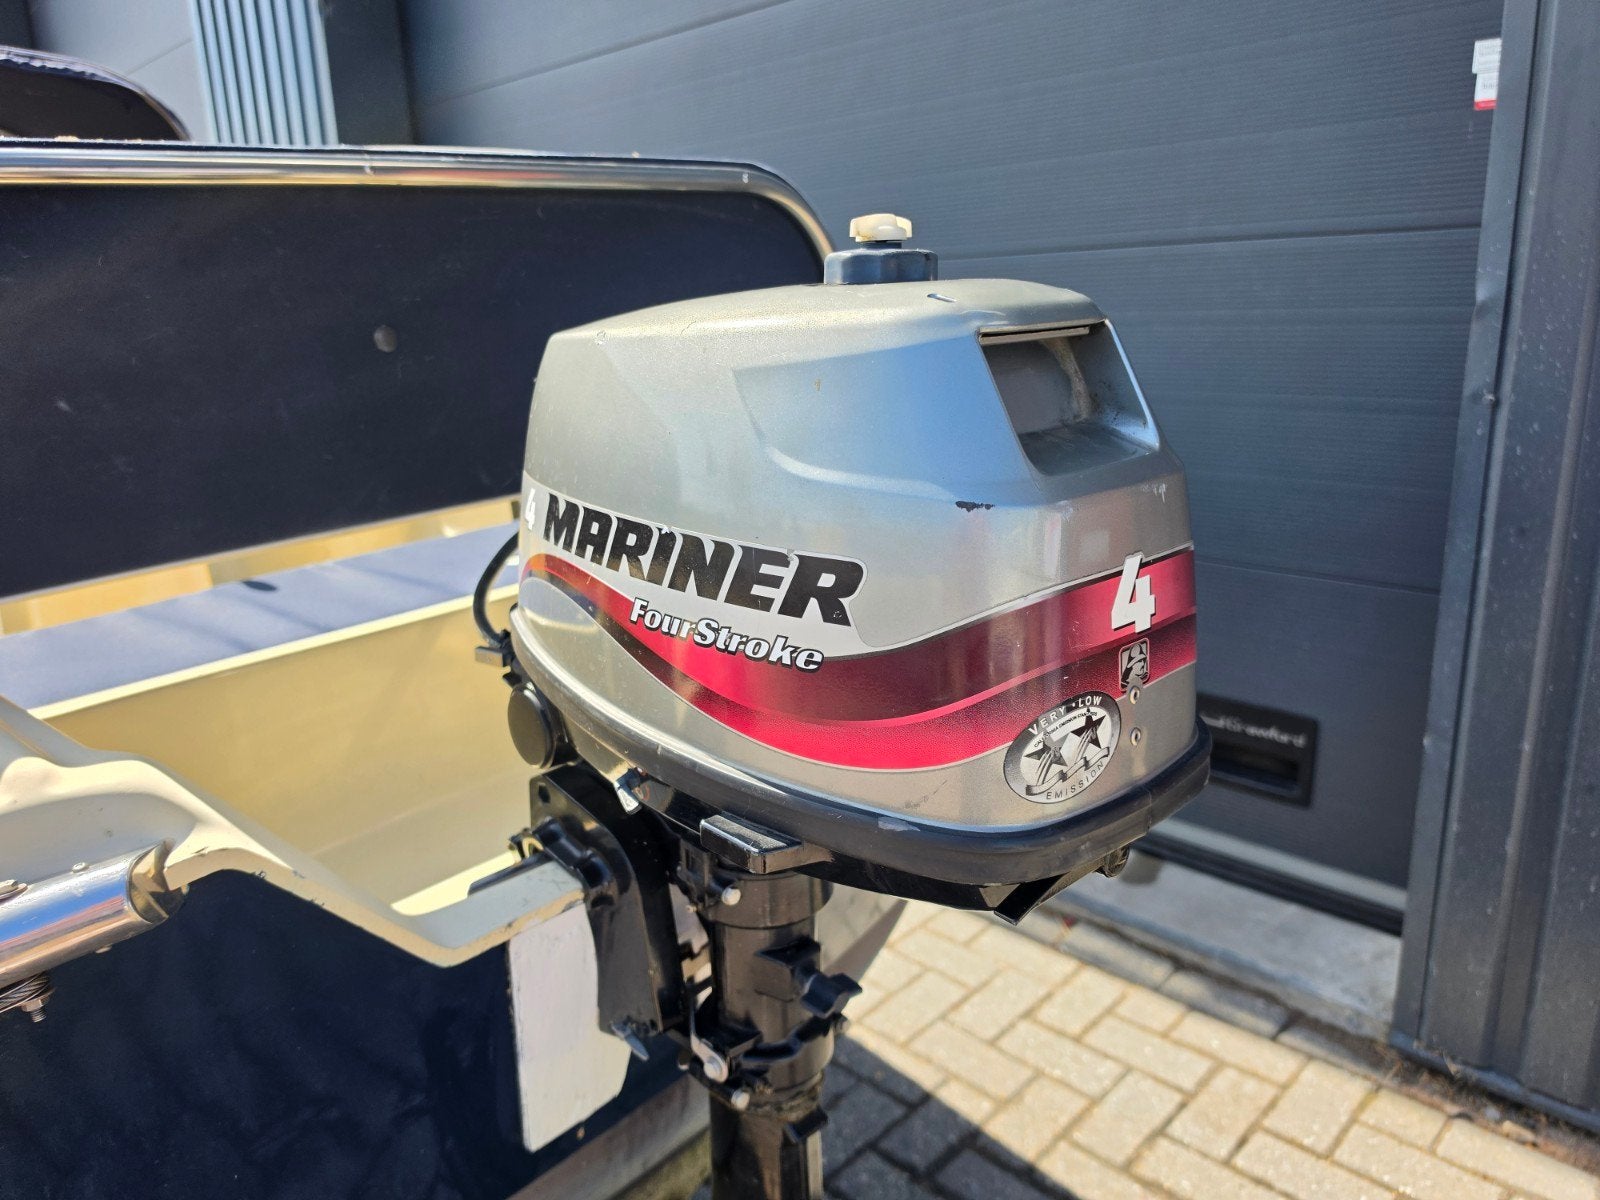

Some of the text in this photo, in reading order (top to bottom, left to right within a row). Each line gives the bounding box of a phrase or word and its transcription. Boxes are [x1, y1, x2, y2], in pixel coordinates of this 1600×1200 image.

[525, 488, 535, 531] 4
[543, 493, 864, 627] MARINER
[1111, 552, 1156, 633] 4
[630, 597, 824, 674] FourStroke
[1028, 695, 1102, 735] VERY LOW
[1046, 762, 1104, 800] EMISSION
